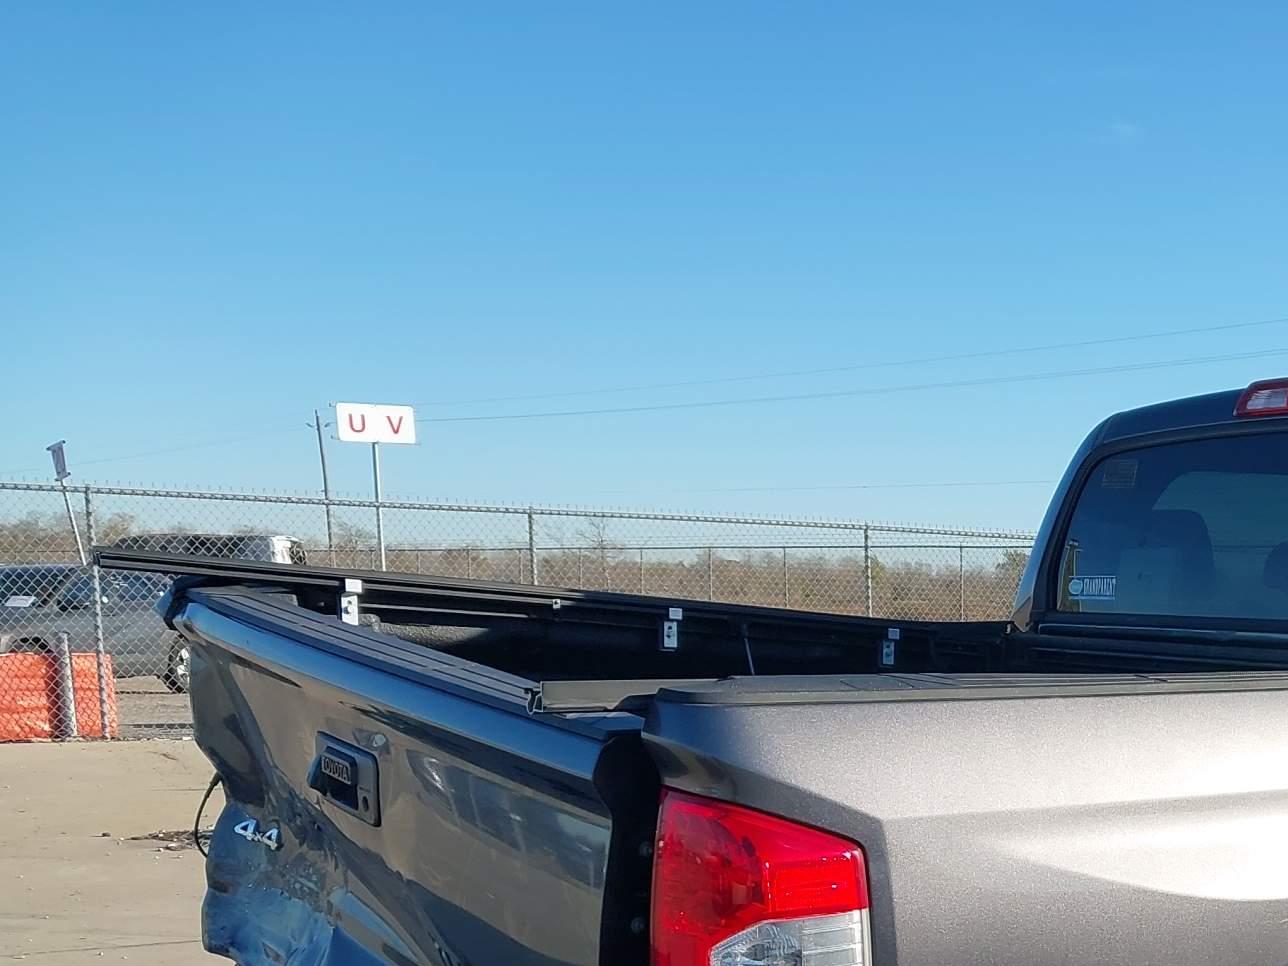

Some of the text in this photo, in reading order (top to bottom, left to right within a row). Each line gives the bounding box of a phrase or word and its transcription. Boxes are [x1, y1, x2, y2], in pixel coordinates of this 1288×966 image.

[348, 413, 403, 435] U V
[322, 756, 350, 784] TOYOTA
